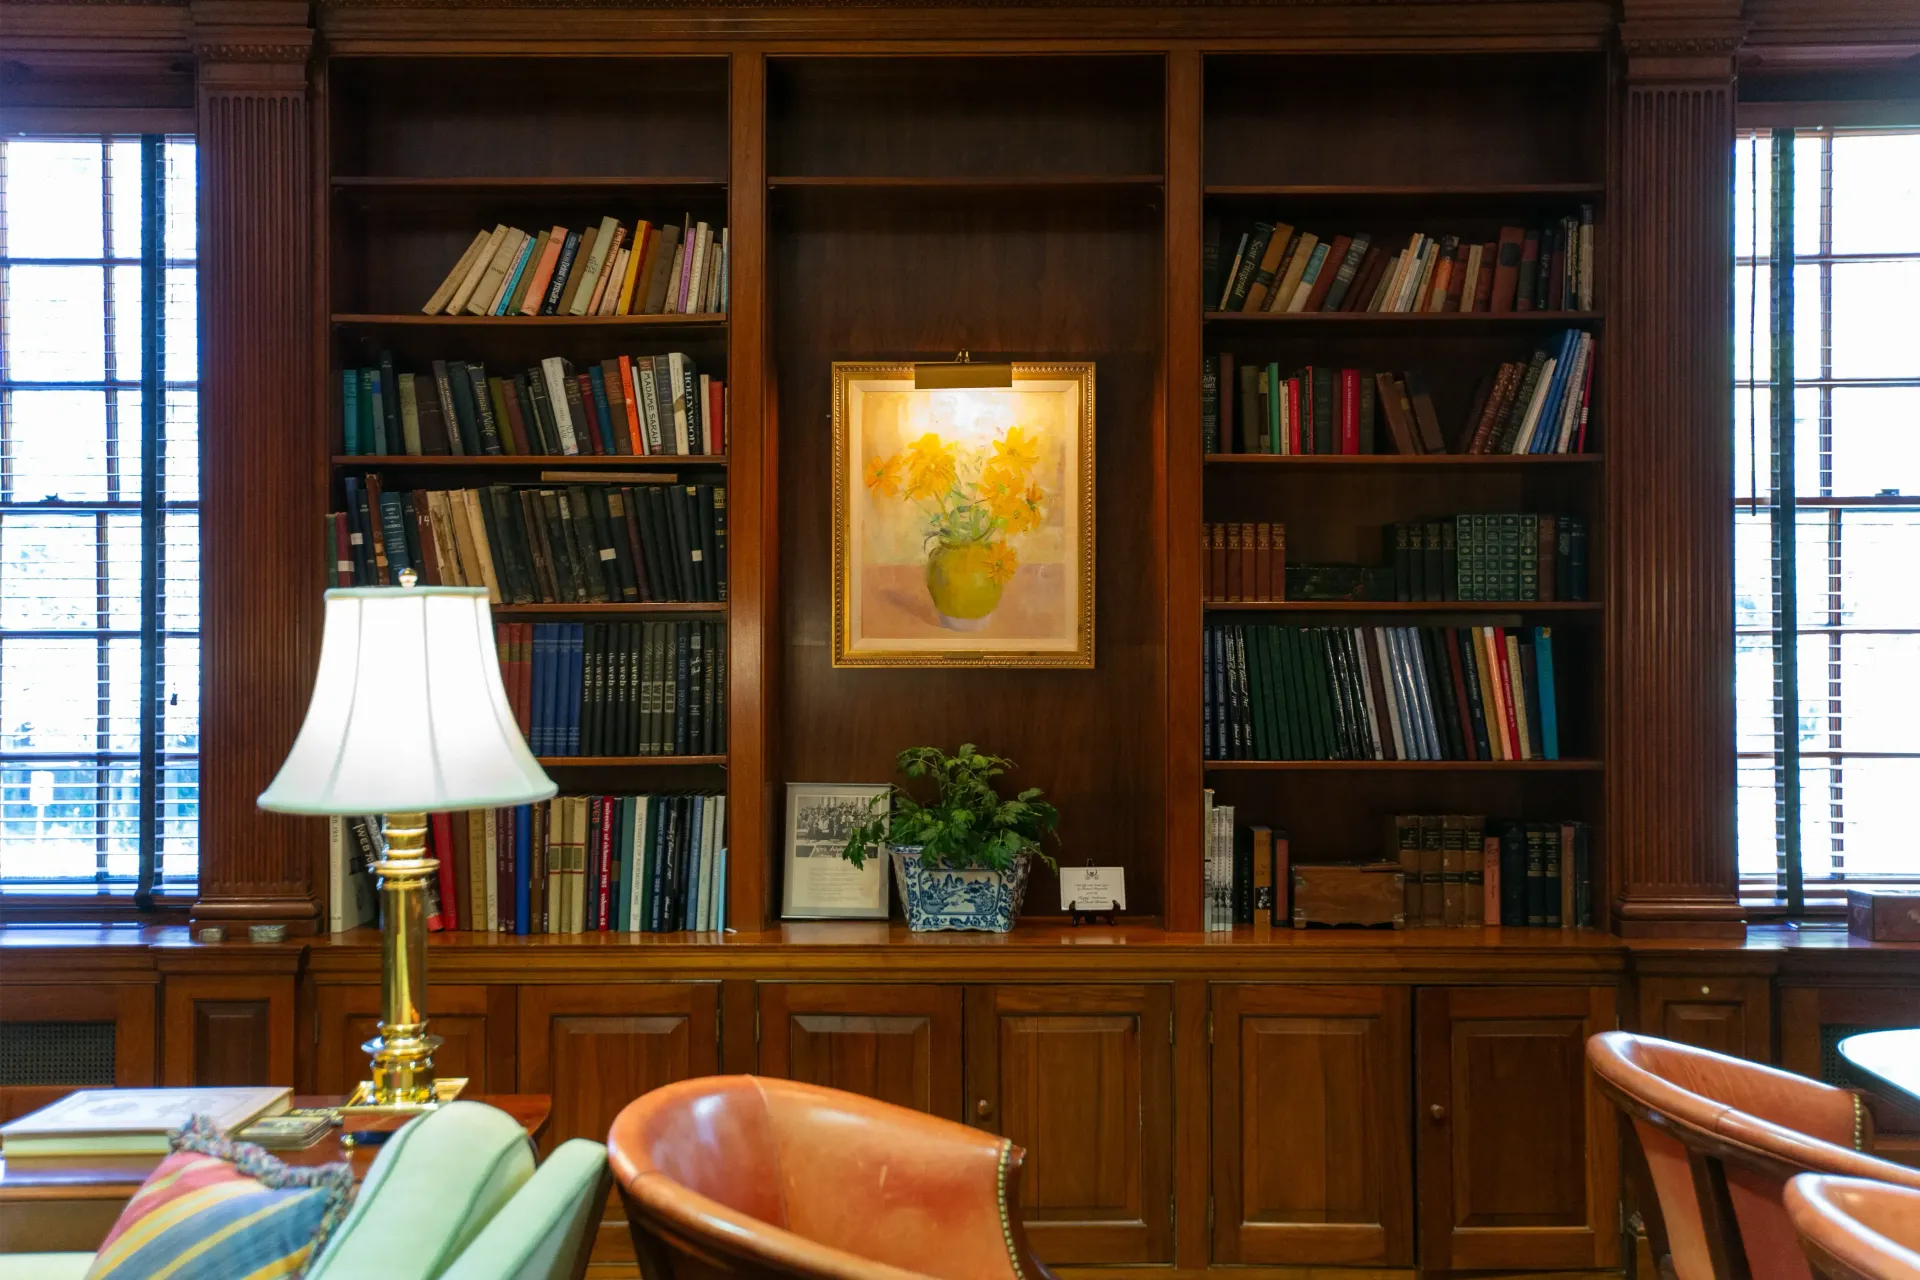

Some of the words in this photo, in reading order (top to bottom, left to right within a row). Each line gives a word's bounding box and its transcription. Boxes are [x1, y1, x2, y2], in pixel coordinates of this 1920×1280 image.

[1248, 239, 1263, 259] Scott
[1235, 260, 1255, 298] Fitzgerald
[549, 281, 563, 304] Jerusalem
[475, 378, 488, 411] Thomas
[644, 373, 654, 411] MADAME
[649, 413, 659, 443] SARAH
[684, 371, 696, 445] HOLLYWOOD
[481, 412, 496, 437] Wolfe
[584, 653, 592, 664] the
[644, 641, 653, 660] The
[655, 640, 664, 659] The
[667, 640, 676, 659] The
[584, 666, 592, 686] web
[595, 667, 603, 687] web
[608, 666, 616, 686] web
[619, 666, 627, 686] web
[631, 665, 639, 686] web
[679, 659, 688, 680] WEB
[642, 682, 651, 712] WEB
[653, 682, 662, 712] WEB
[665, 682, 675, 712] WEB
[592, 800, 601, 823] WEB
[603, 802, 611, 831] university
[356, 827, 370, 851] WEB
[603, 833, 610, 841] of
[652, 895, 660, 919] VOLUME
[600, 917, 606, 926] 64
